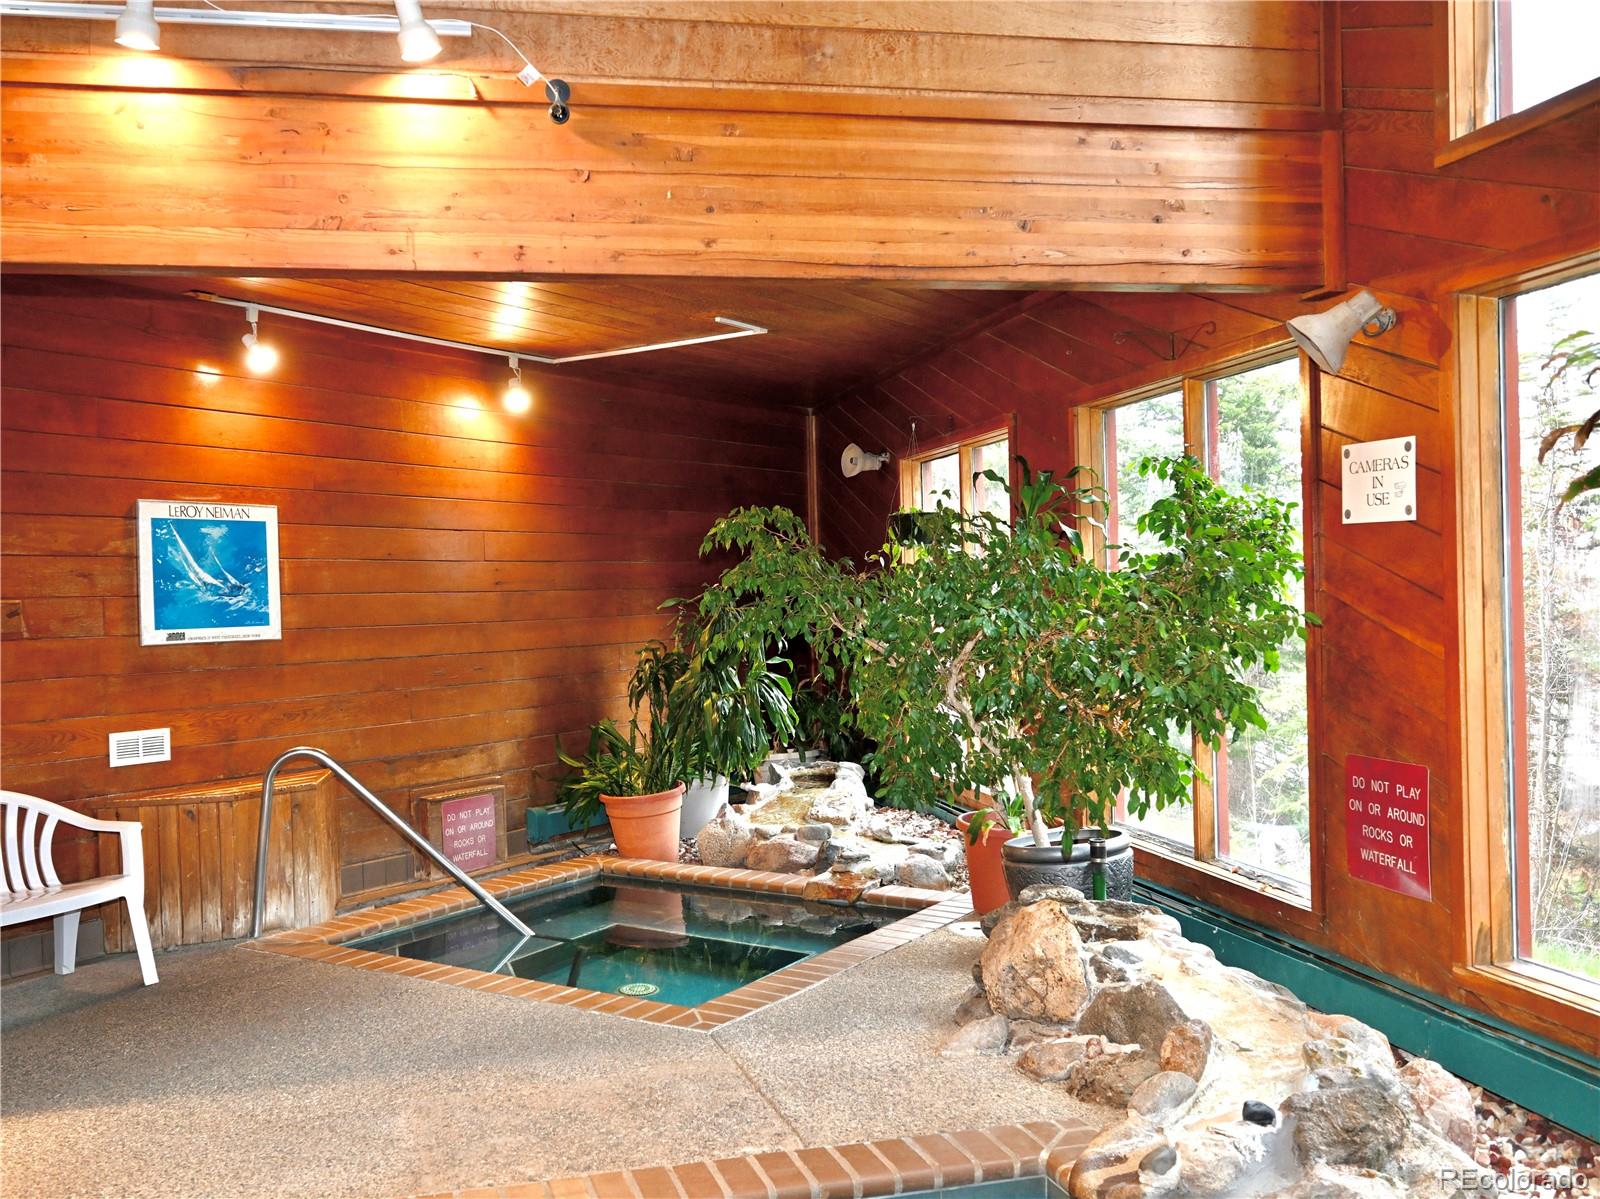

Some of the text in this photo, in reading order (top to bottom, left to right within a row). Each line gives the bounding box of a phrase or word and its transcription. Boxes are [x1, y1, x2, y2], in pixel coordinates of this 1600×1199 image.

[1349, 455, 1409, 474] CAMERAS
[1372, 475, 1384, 489] IN
[1366, 491, 1390, 507] USE
[206, 507, 250, 519] NEIMAN
[1352, 775, 1421, 801] DO NOT PLAY
[446, 806, 491, 822] DO NOT PLAY
[1349, 798, 1425, 826] ON OR AROUND
[445, 820, 493, 837] ON OR AROUND
[1362, 824, 1413, 849] ROCKS OR
[453, 834, 487, 848] ROCKS OR
[453, 848, 488, 862] WATERFALL
[1361, 848, 1416, 874] WATERFALL
